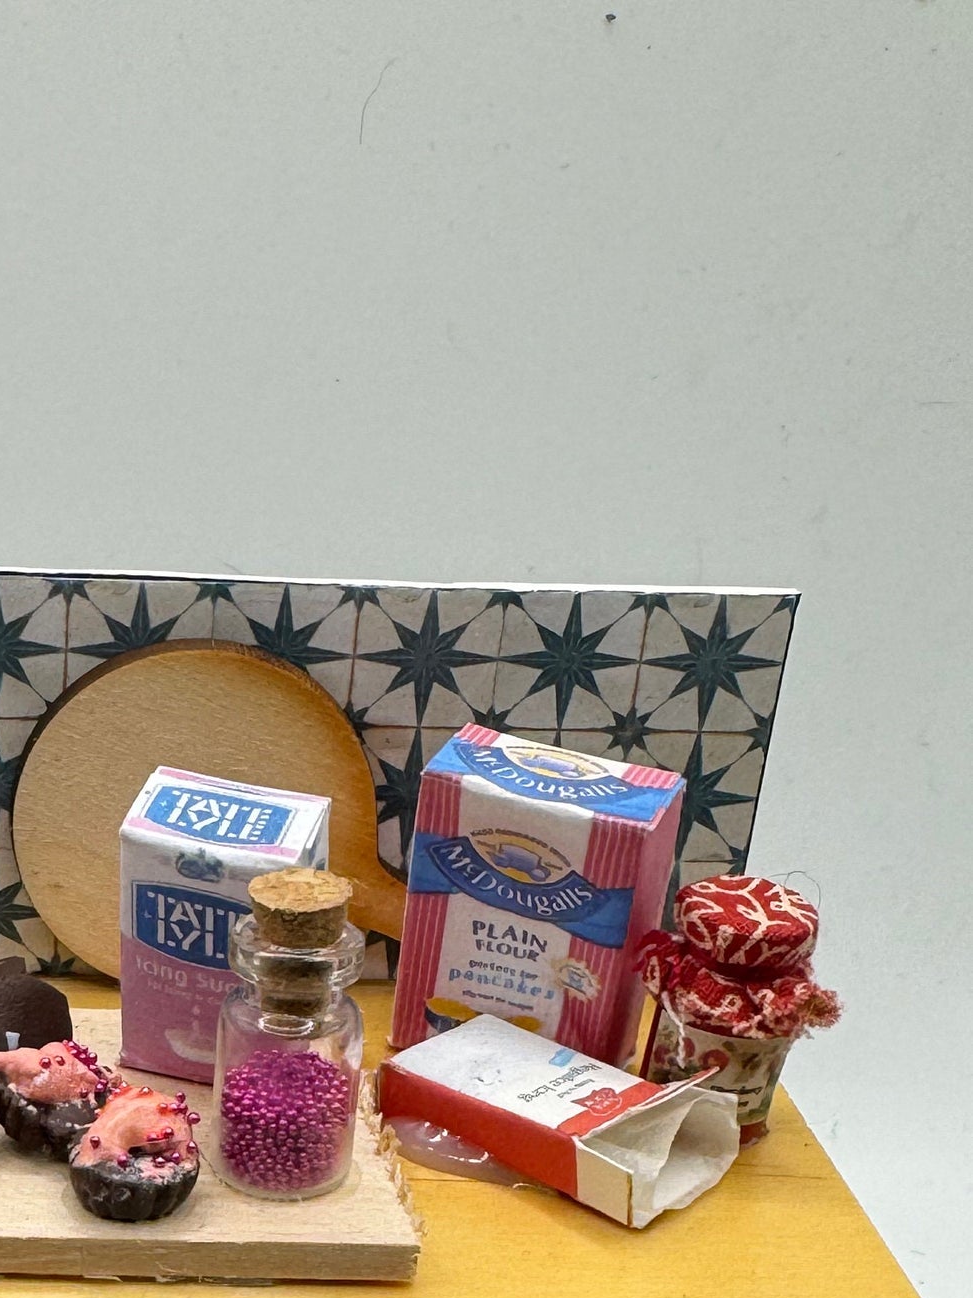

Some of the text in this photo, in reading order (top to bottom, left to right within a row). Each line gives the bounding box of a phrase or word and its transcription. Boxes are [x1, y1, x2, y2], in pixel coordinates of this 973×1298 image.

[440, 845, 593, 916] McDougalls
[471, 920, 548, 953] PLAIN
[474, 939, 540, 962] FLOUR
[448, 968, 555, 1000] pancakes
